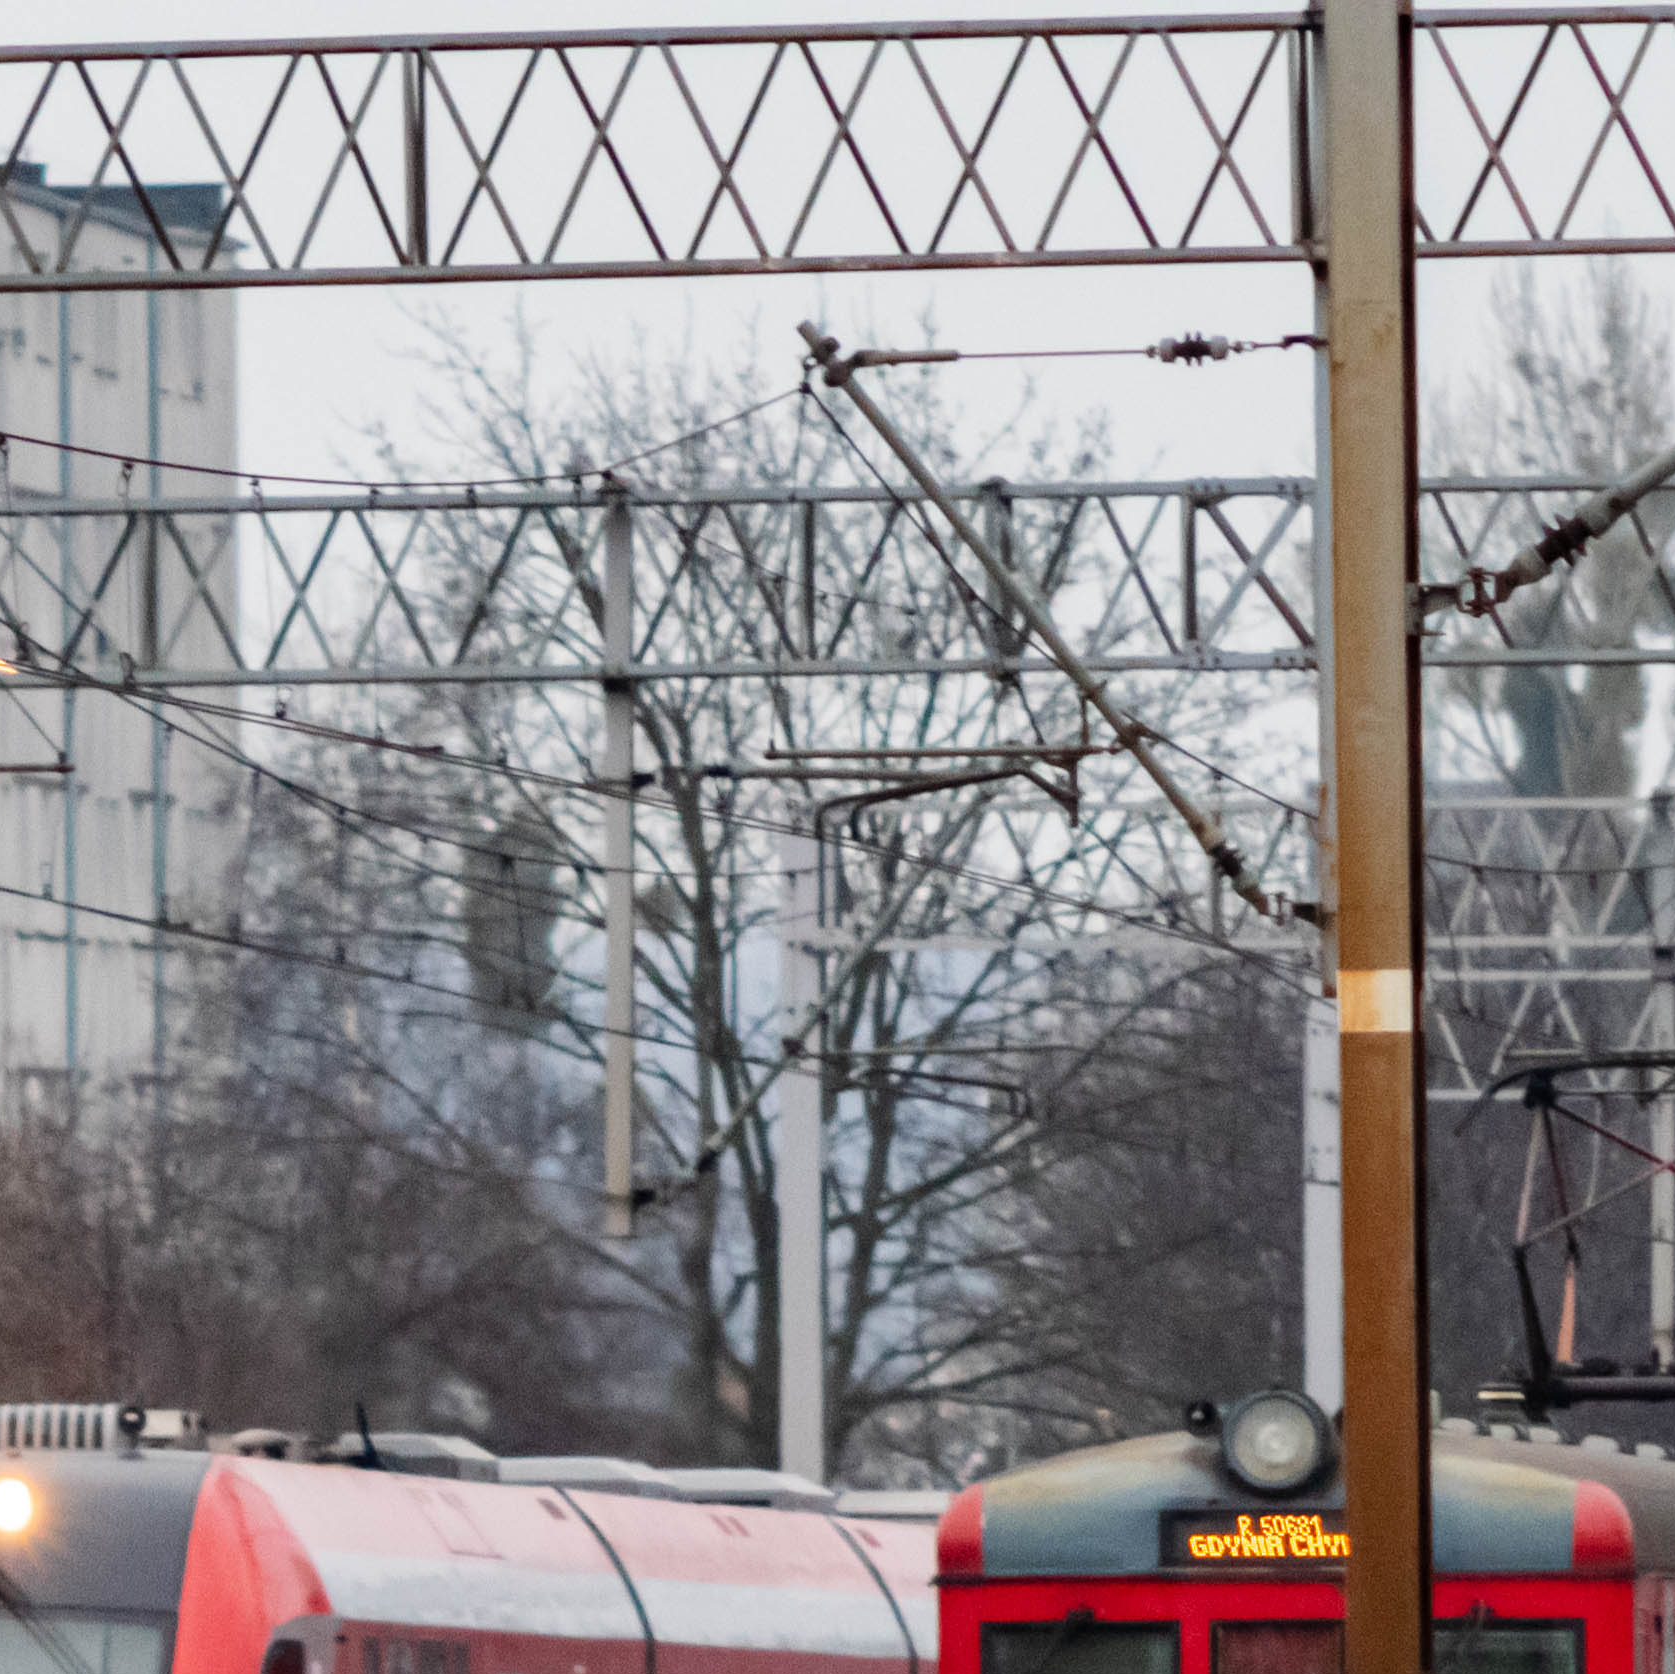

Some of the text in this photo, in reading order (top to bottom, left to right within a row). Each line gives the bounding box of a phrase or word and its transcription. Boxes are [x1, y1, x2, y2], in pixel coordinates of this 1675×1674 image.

[1237, 1514, 1322, 1537] R 50681
[1189, 1533, 1285, 1558] GDYNIA
